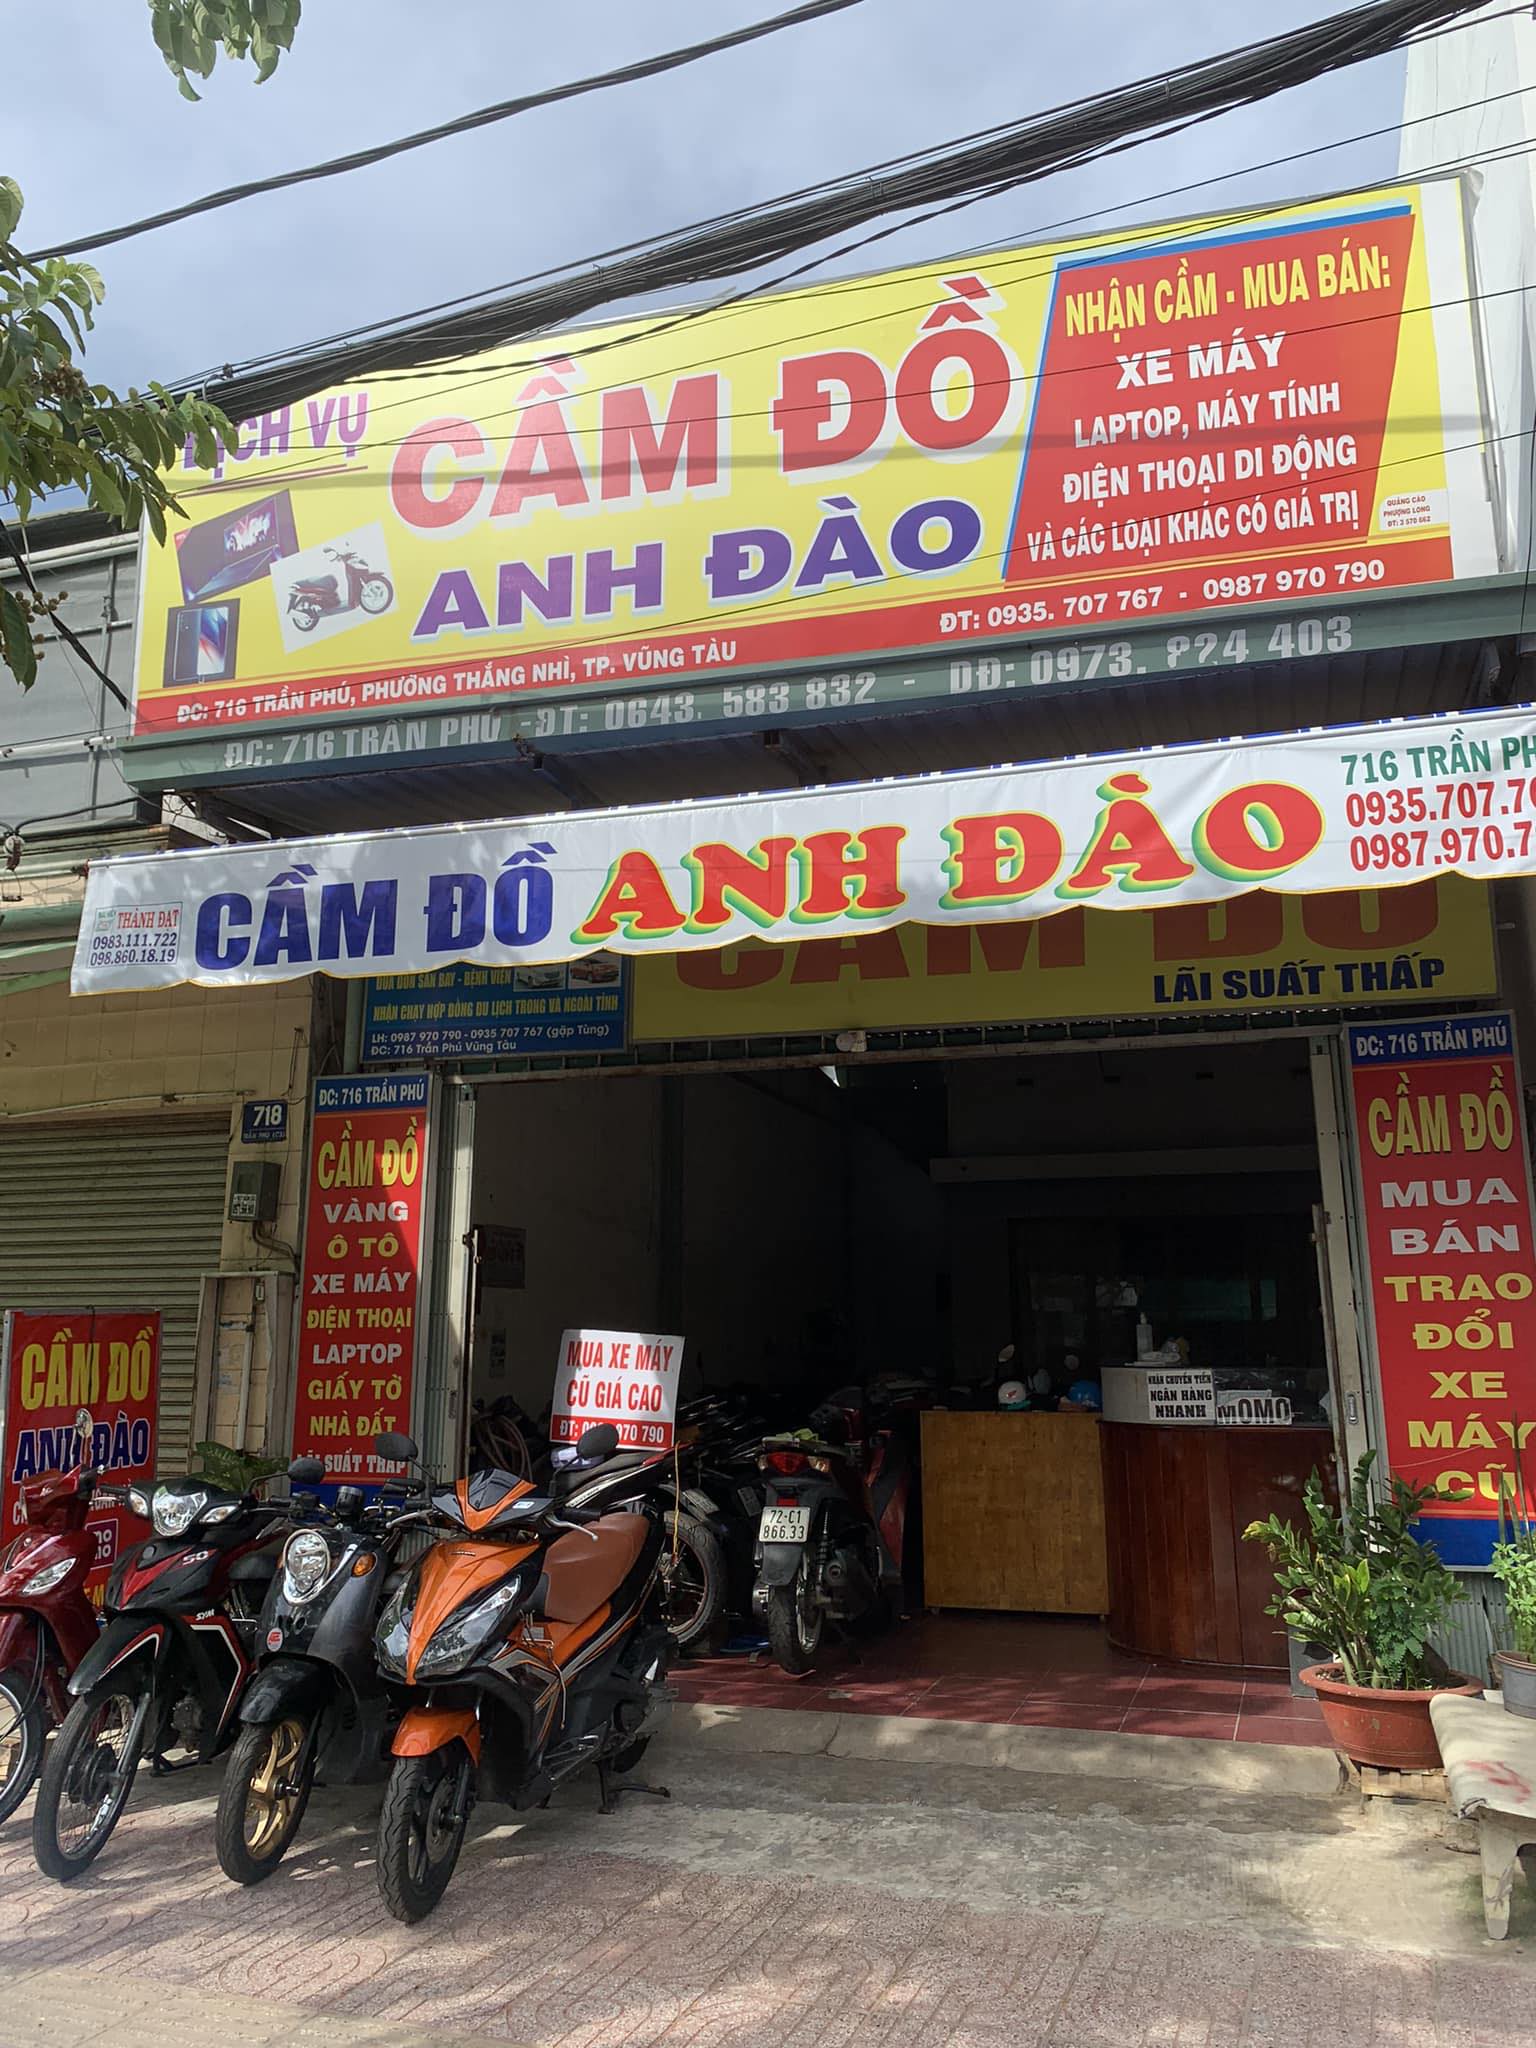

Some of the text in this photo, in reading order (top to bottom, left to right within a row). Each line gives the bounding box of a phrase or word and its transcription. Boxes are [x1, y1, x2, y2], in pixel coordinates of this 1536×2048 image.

[1065, 238, 1391, 343] NHẬN CẦM MUA BÁN:
[1116, 327, 1287, 390] XE MÁY
[390, 276, 1012, 530] CẦM ĐỒ
[1074, 380, 1340, 448] LAPTOP, MÁY TÍNH
[307, 392, 368, 457] VỤ
[1062, 434, 1357, 509] ĐIỆN THOẠI DI ĐỘNG
[1027, 489, 1359, 562] VÀ CÁC LOẠI KHÁC CÓ GIÁ TRỊ
[411, 496, 982, 638] ANH ĐÀO
[939, 559, 1385, 633] ĐT: 0935. 707 767 0987 970 790
[177, 703, 209, 724] ĐC:
[214, 700, 247, 719] 716
[252, 685, 305, 714] TRẦN
[310, 680, 356, 707] PHÚ,
[453, 662, 526, 692] THẮNG
[532, 655, 577, 683] NHÌ,
[583, 656, 616, 678] TP.
[622, 646, 685, 673] VŨNG
[691, 638, 738, 663] TÀU
[281, 729, 336, 764] 716
[342, 716, 428, 758] TRẦN
[440, 706, 502, 748] PHÚ
[604, 691, 702, 731] 0643.
[722, 682, 790, 719] 583
[806, 672, 877, 711] 832
[949, 657, 1016, 694] DĐ:
[1030, 641, 1147, 686] 0973.
[1267, 615, 1352, 659] 403
[1340, 728, 1492, 786] 716 TRẦN
[194, 772, 1327, 970] CẦM ĐỒ ANH ĐÀO
[90, 948, 175, 966] 098.860.18.19
[92, 932, 178, 950] 0983.111.722
[1153, 951, 1445, 1003] LÃI SUẤT THẤP
[515, 997, 546, 1015] TRONG
[371, 1033, 388, 1043] LH:
[390, 1031, 417, 1042] 0987
[418, 1030, 440, 1041] 970
[441, 1029, 462, 1041] 790
[470, 1028, 497, 1039] 0935
[499, 1027, 520, 1038] 707
[523, 1026, 543, 1037] 767
[371, 1044, 391, 1056] ĐC:
[393, 1044, 414, 1055] 716
[441, 1039, 463, 1052] Phú
[495, 1038, 517, 1051] Tàu
[1356, 1020, 1508, 1057] ĐC: 716 TRẦN PHÚ
[318, 1077, 425, 1106] ĐC: 716 TRẦN PHÚ
[252, 1104, 283, 1127] 718
[1367, 1065, 1514, 1157] CẦM ĐỒ
[317, 1115, 419, 1190] CẦM ĐỒ
[1379, 1176, 1520, 1209] MUA
[322, 1197, 409, 1224] VÀNG
[327, 1231, 399, 1260] Ô TÔ
[1389, 1218, 1521, 1256] BÁN
[311, 1267, 411, 1294] XE MÁY
[1383, 1272, 1534, 1303] TRAO
[306, 1304, 412, 1335] ĐIỆN THOẠI
[1412, 1308, 1514, 1351] ĐỔI
[21, 1326, 154, 1411] CẦM ĐỒ
[312, 1343, 403, 1365] LAPTOP
[567, 1338, 674, 1372] MUA XE MÁY
[307, 1371, 402, 1401] GIẤY TỜ
[566, 1375, 663, 1413] CŨ GIÁ CAO
[1150, 1386, 1213, 1402] NGÂN HÀNG
[1429, 1371, 1508, 1399] XE
[309, 1407, 397, 1437] NHÀ ĐẤT
[1154, 1404, 1207, 1418] NHANH
[91, 1410, 150, 1469] ĐÀO
[560, 1420, 578, 1437] ĐT:
[641, 1425, 665, 1444] 790
[1407, 1413, 1536, 1450] MÁY
[324, 1447, 363, 1474] SUẤT
[1435, 1462, 1518, 1502] CŨ
[763, 1525, 805, 1540] 866.33
[770, 1509, 802, 1524] 72-C1
